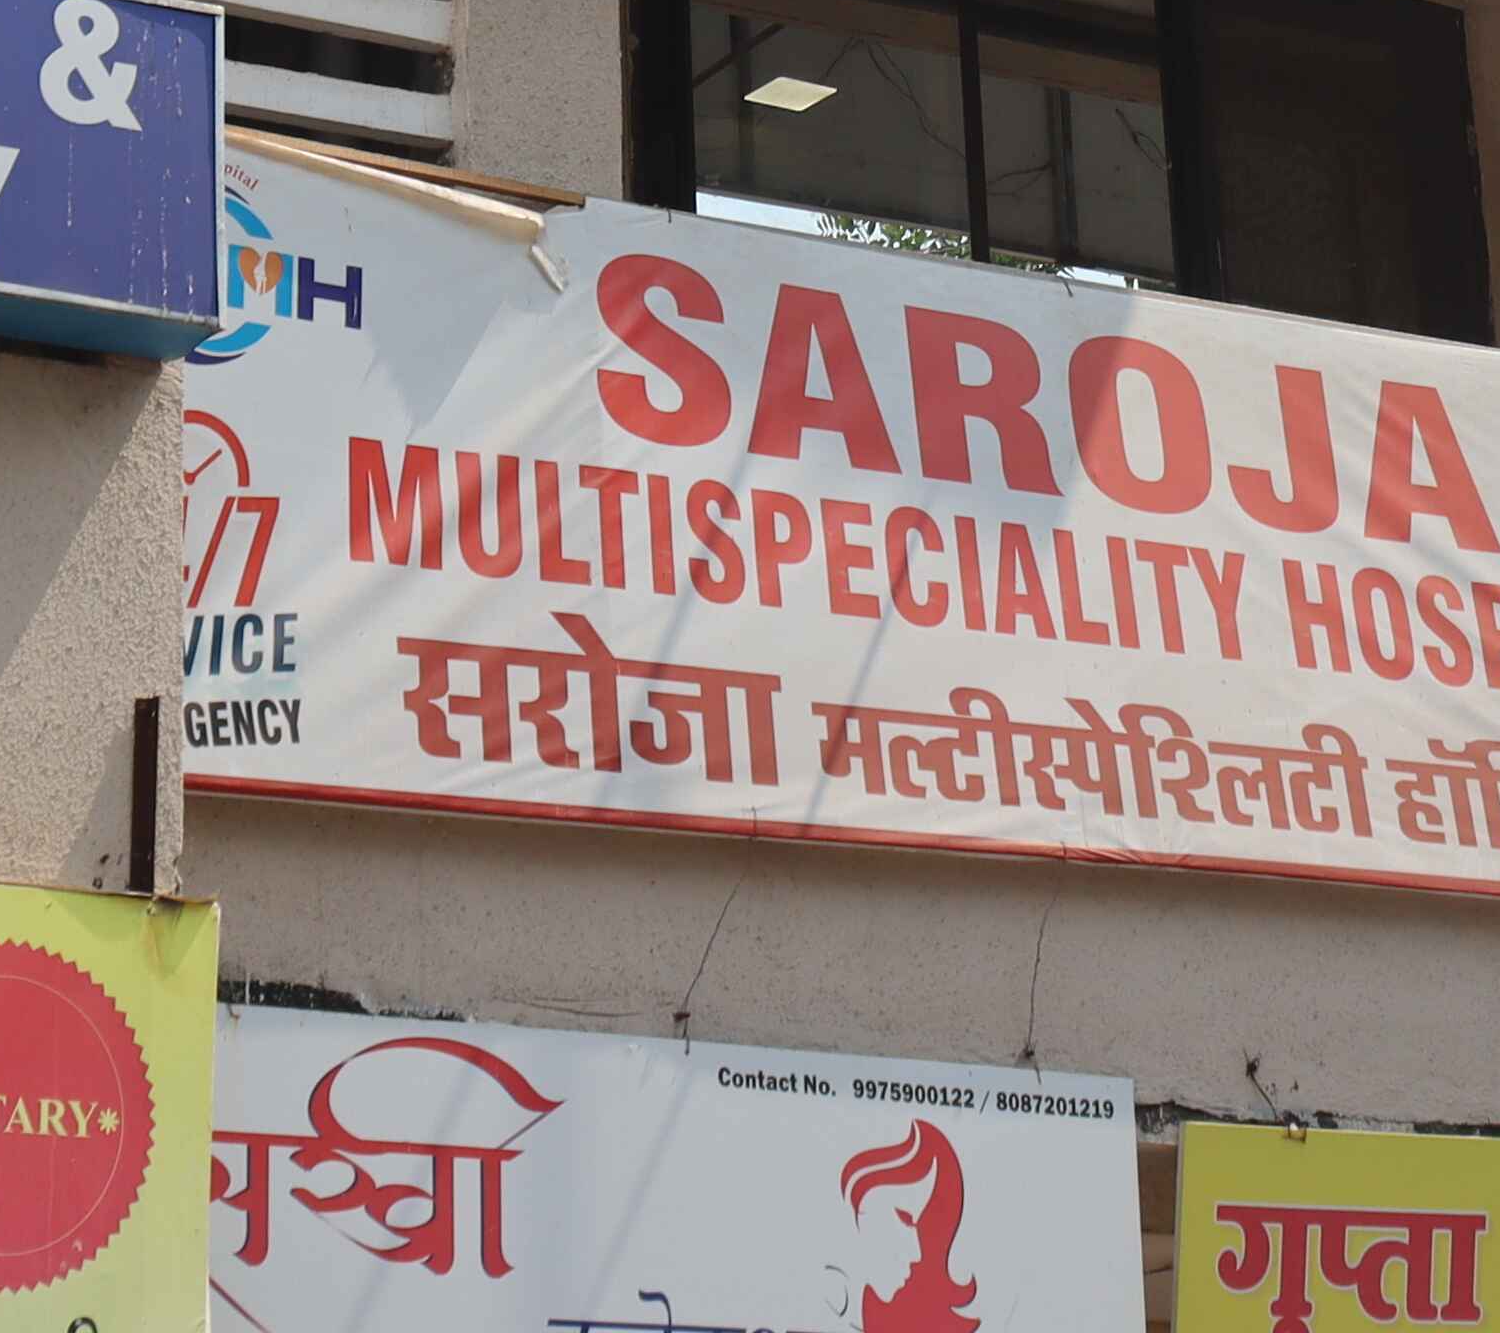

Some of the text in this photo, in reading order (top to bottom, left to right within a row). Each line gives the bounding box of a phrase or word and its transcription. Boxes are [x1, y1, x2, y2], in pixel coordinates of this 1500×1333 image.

[224, 159, 261, 193] pital
[227, 243, 364, 330] MH
[184, 495, 280, 609] /7
[348, 435, 1247, 664] MULTISPECIALITY
[183, 612, 298, 677] VICE
[184, 697, 303, 750] GENCY
[396, 609, 785, 787] सरोजा
[717, 1066, 799, 1095] Contact
[803, 1075, 837, 1097] No.
[852, 1078, 976, 1110] 9975900122
[995, 1090, 1115, 1120] 8087201219
